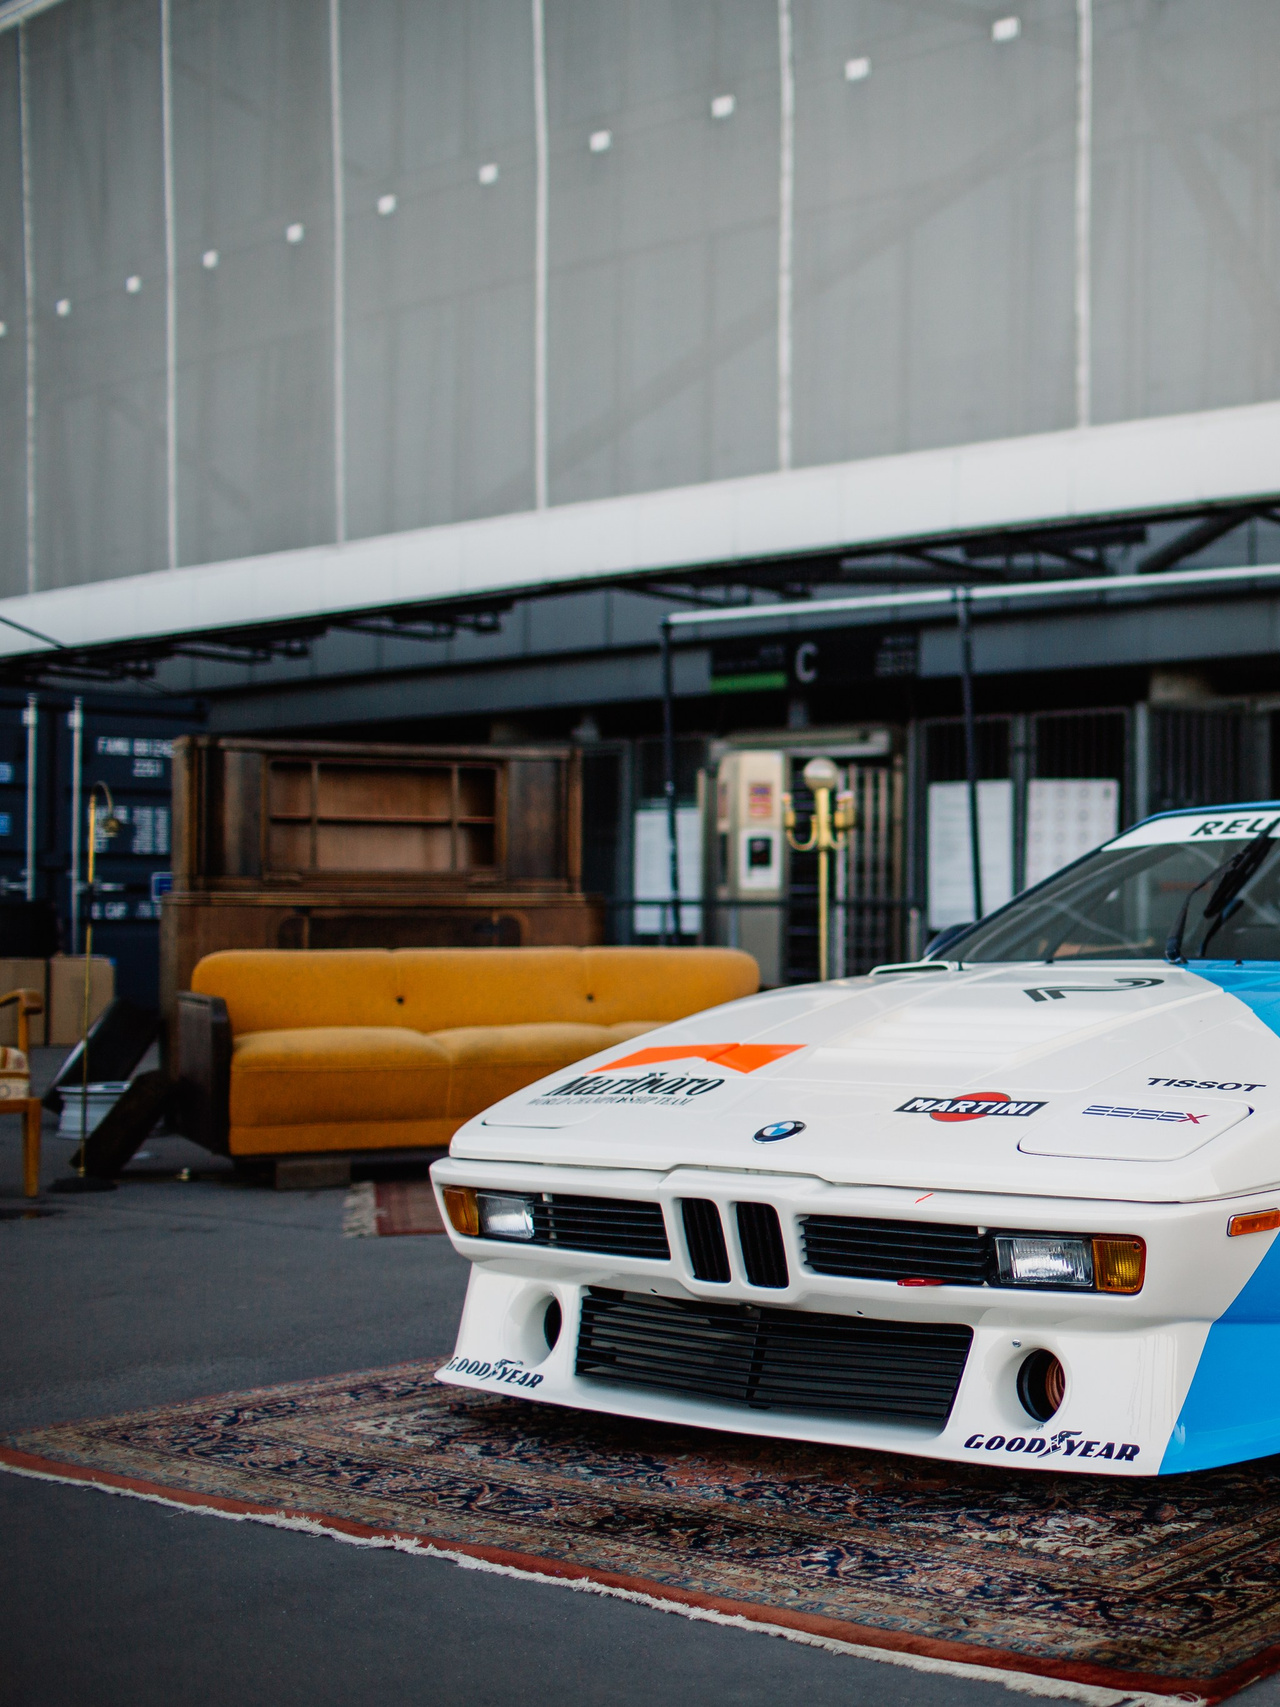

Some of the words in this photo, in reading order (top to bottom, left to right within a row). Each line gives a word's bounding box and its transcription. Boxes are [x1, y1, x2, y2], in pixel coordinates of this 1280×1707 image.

[542, 1071, 726, 1097] Marlboro
[1147, 1077, 1267, 1093] TISSOT
[904, 1097, 1040, 1117] MARTINI
[1081, 1104, 1210, 1125] ESSEX
